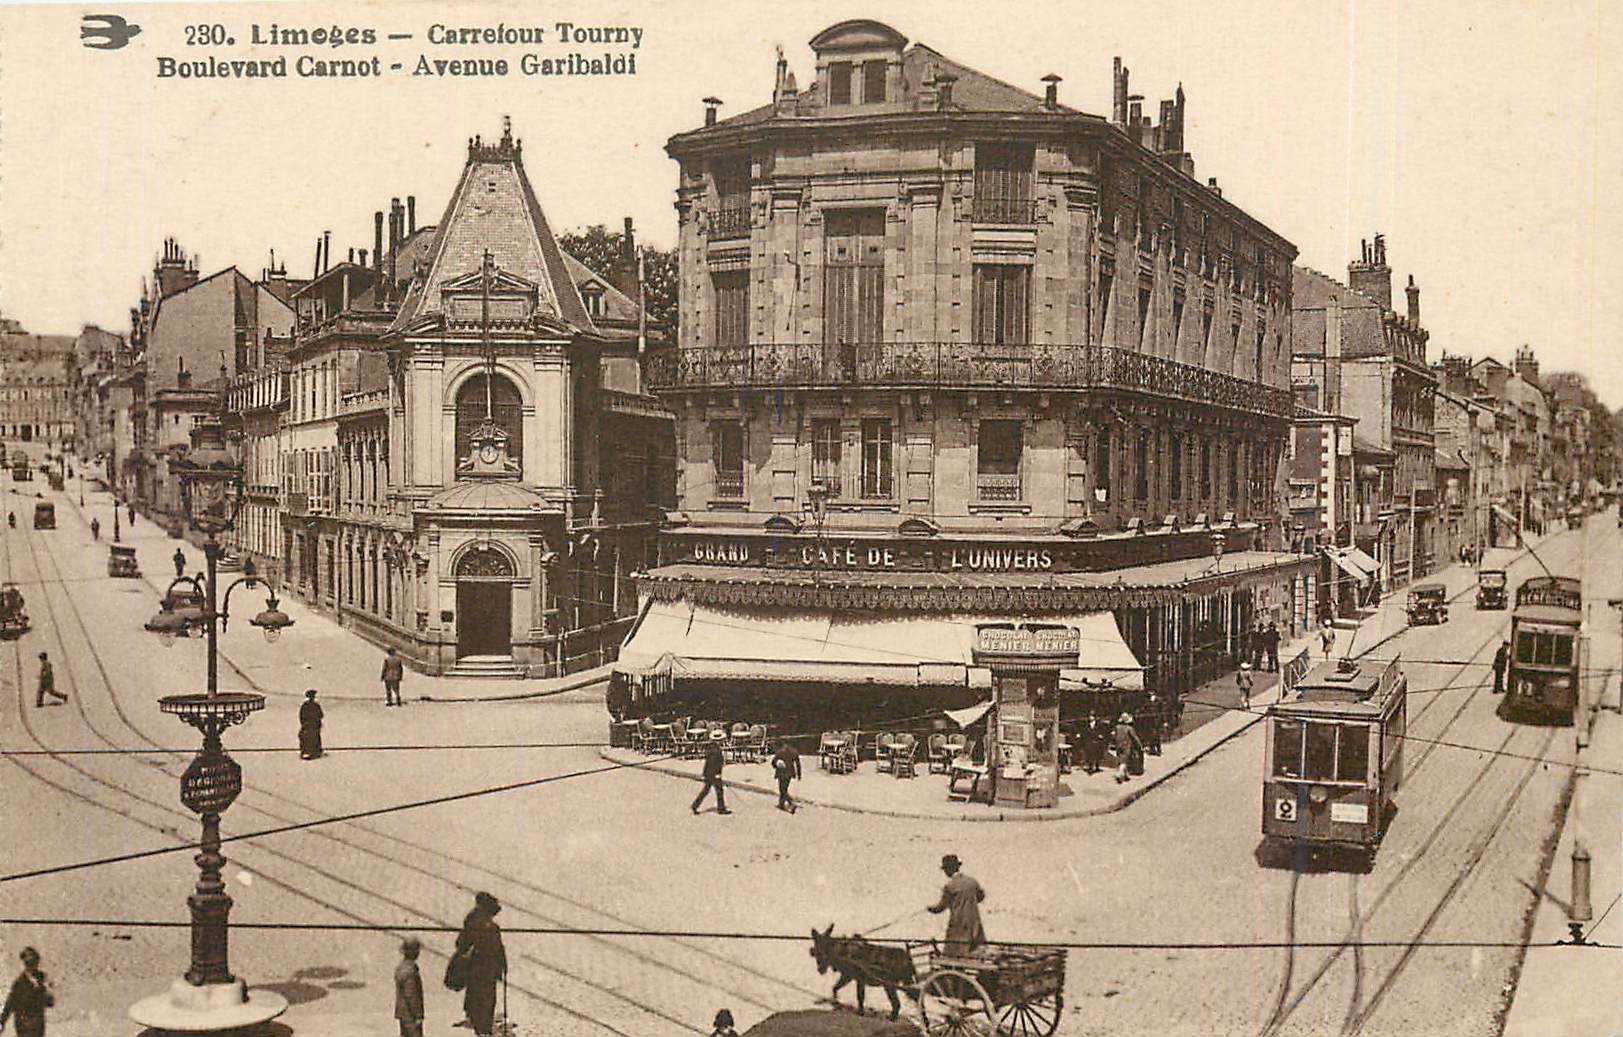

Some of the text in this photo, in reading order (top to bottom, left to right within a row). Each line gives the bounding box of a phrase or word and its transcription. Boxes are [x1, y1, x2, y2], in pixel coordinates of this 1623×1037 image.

[694, 540, 1052, 568] GRAND CAFÉ DE L'UNIVERS
